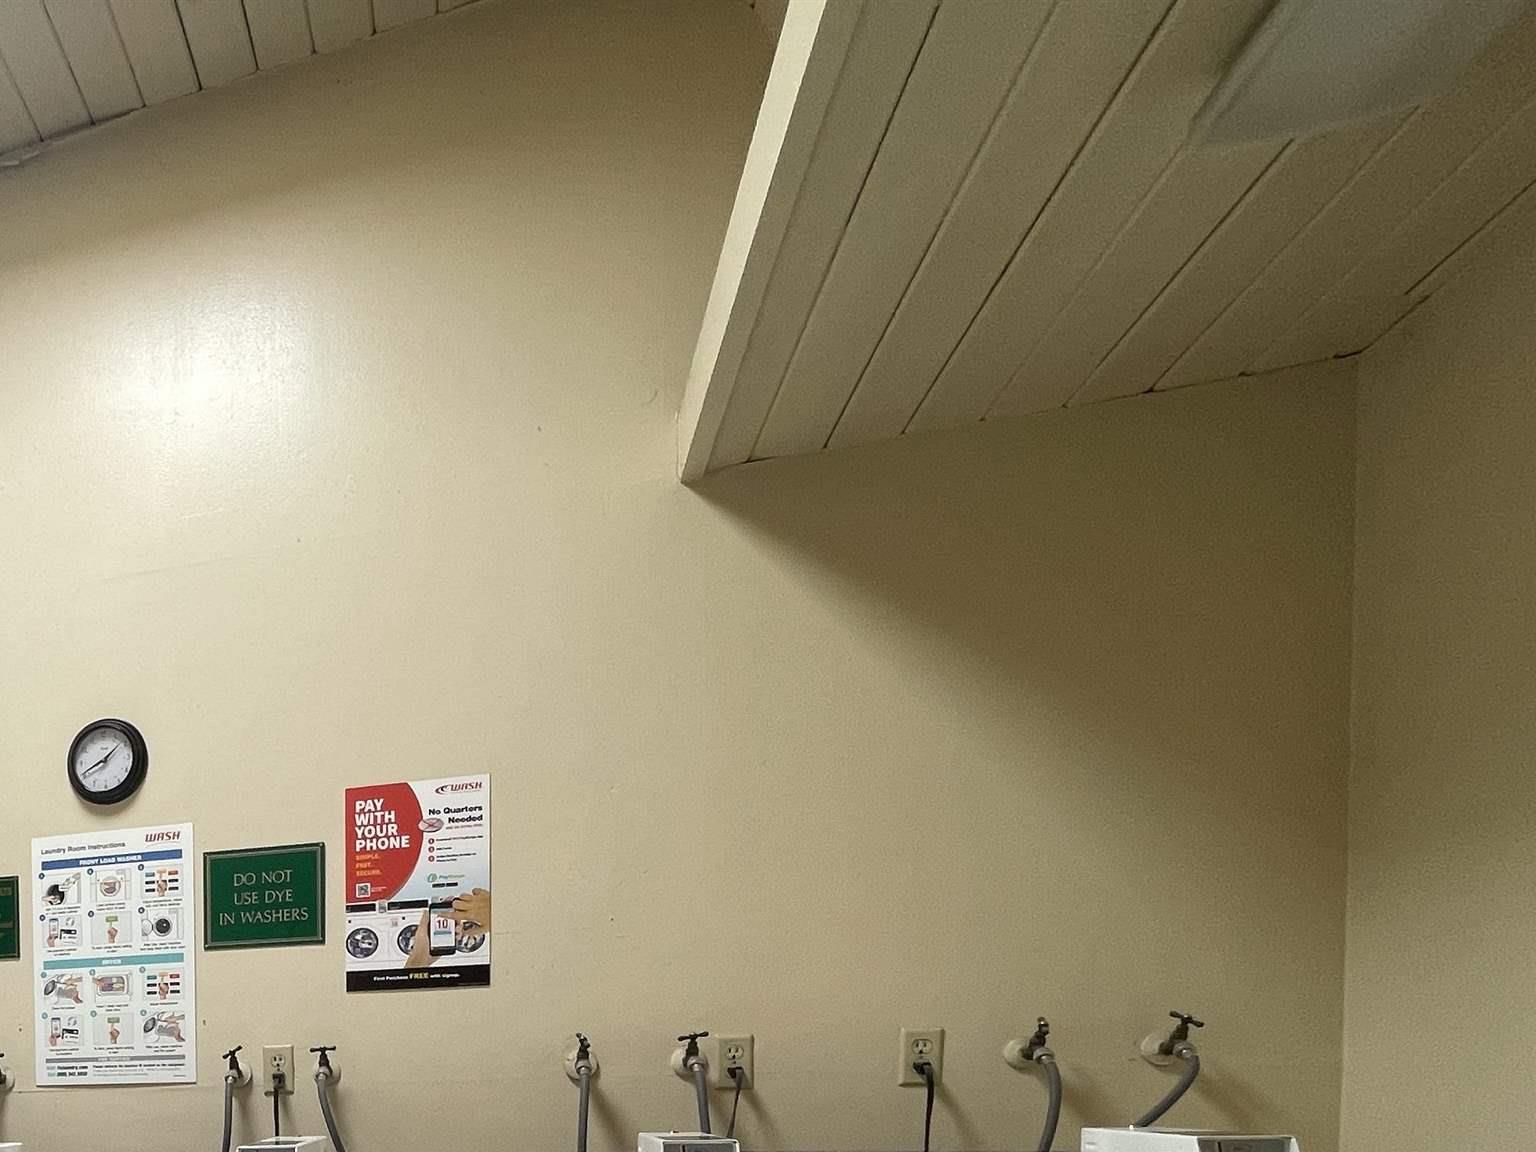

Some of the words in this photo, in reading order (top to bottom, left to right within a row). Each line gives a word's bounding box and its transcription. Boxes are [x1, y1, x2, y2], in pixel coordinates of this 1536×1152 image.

[355, 799, 384, 812] PAY
[443, 805, 483, 814] Quarters
[355, 811, 396, 826] WITH
[448, 814, 483, 823] Needed
[145, 831, 181, 843] WASH
[355, 824, 398, 838] YOUR
[41, 847, 66, 855] Laundry
[88, 842, 126, 850] Instructions
[356, 836, 410, 852] PHONE
[234, 872, 256, 886] DO
[262, 869, 293, 884] NOT
[234, 892, 259, 905] USE
[265, 889, 293, 903] DYE
[219, 912, 235, 926] IN
[240, 907, 309, 923] WASHERS
[437, 919, 449, 929] 10
[409, 972, 429, 980] FREE
